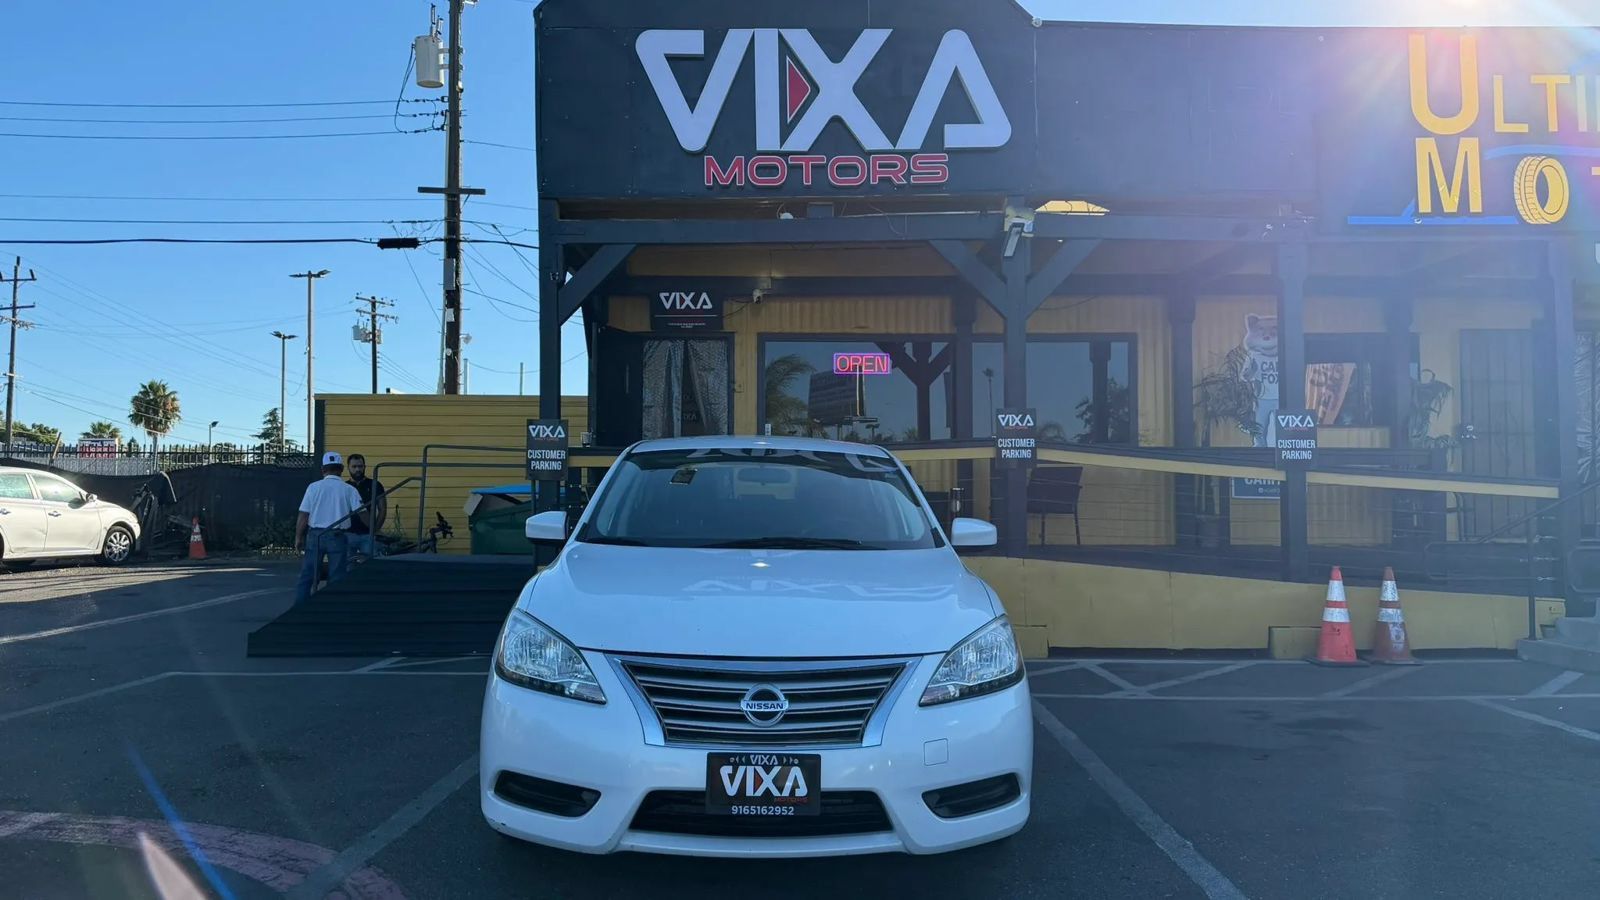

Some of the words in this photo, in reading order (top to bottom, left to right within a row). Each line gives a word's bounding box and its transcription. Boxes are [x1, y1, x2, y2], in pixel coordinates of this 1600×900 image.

[635, 28, 1012, 152] VIXA
[1408, 34, 1600, 135] ULTI
[704, 153, 949, 187] MOTORS
[659, 292, 713, 310] VIXA
[836, 355, 888, 372] OPEN
[1261, 360, 1279, 373] CA
[998, 414, 1035, 427] VIXA
[1277, 415, 1315, 428] VIXA
[528, 425, 566, 438] VIXA
[997, 438, 1036, 448] CUSTOMER
[1277, 439, 1316, 449] CUSTOMER
[527, 449, 566, 459] CUSTOMER
[1001, 449, 1032, 459] PARKING
[1281, 450, 1313, 460] PARKING
[530, 460, 562, 470] PARKING
[745, 702, 784, 710] NISSAN
[750, 754, 779, 765] VIXA
[720, 765, 808, 797] VIXA
[731, 805, 795, 816] 9165162952
